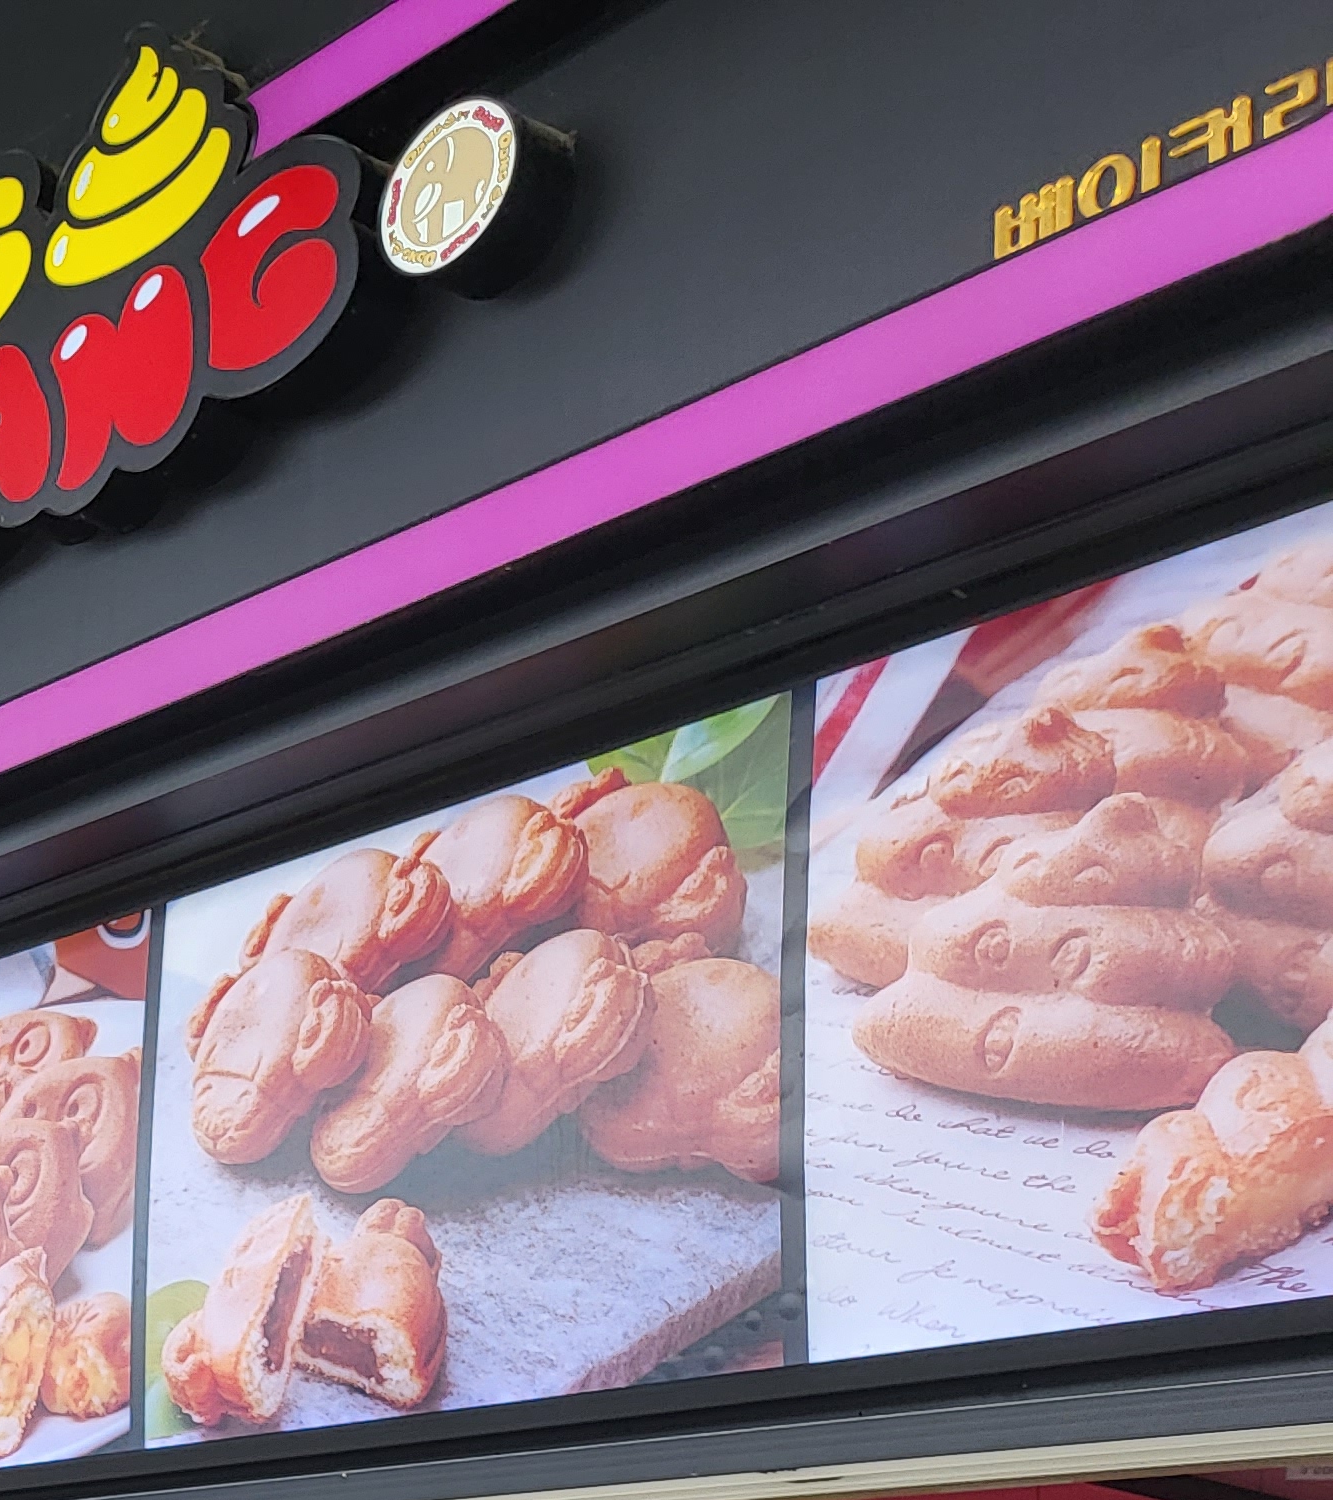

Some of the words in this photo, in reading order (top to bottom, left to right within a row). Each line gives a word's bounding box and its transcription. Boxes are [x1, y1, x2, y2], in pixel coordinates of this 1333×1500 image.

[937, 1117, 1016, 1139] what
[1073, 1140, 1116, 1159] do
[1240, 1264, 1313, 1292] The
